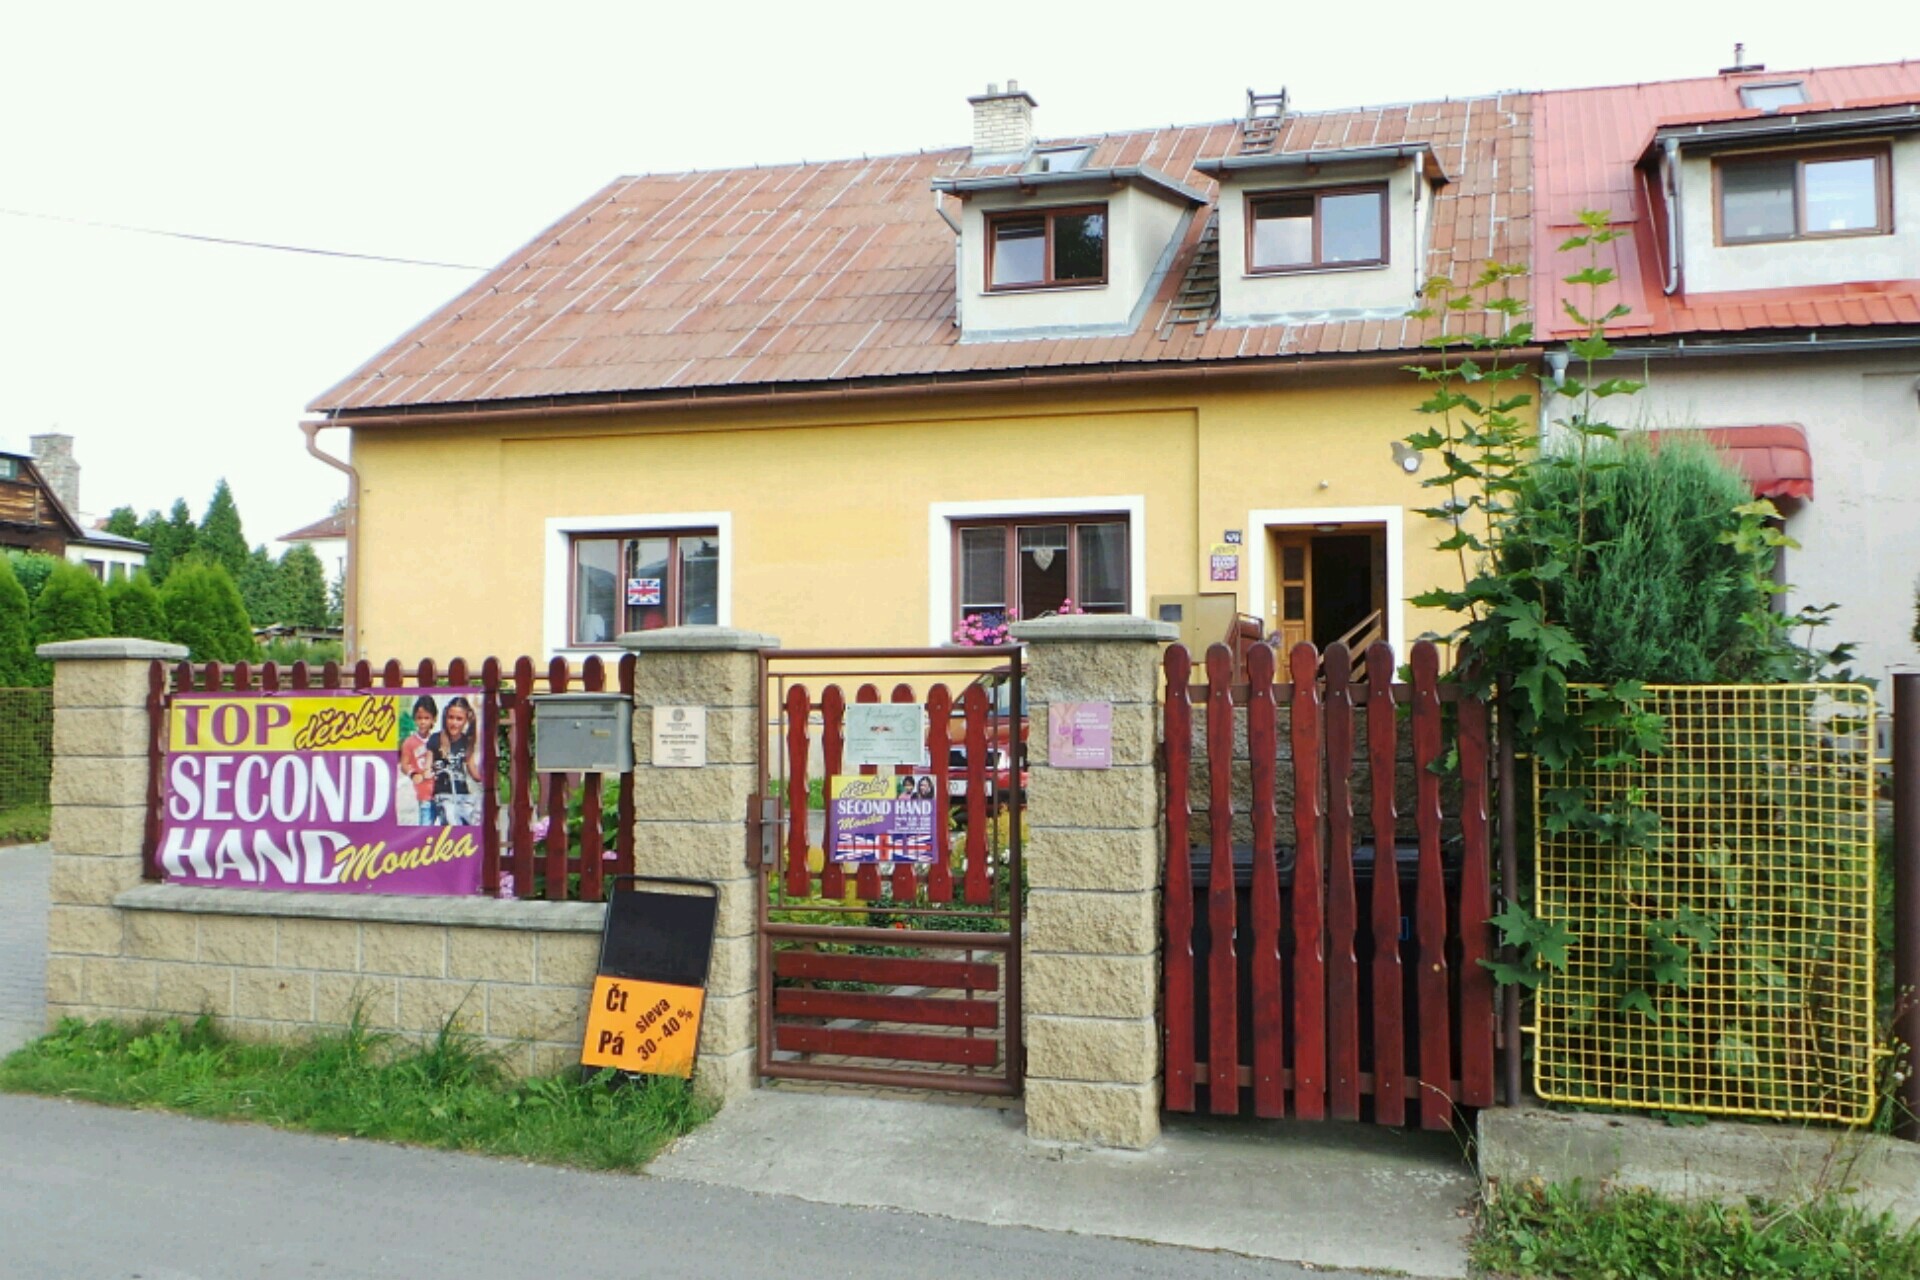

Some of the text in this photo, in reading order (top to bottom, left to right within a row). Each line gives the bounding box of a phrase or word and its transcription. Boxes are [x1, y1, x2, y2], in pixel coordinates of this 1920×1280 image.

[175, 696, 396, 751] TOP dětský
[169, 755, 390, 823] SECOND
[838, 800, 932, 815] SECOND HAND
[162, 826, 479, 885] HAND Monika
[606, 983, 629, 1012] Čt
[635, 999, 671, 1034] sleva
[598, 1030, 625, 1056] Pá
[637, 1039, 657, 1061] 30
[662, 1017, 681, 1038] 40
[677, 1005, 694, 1022] %
